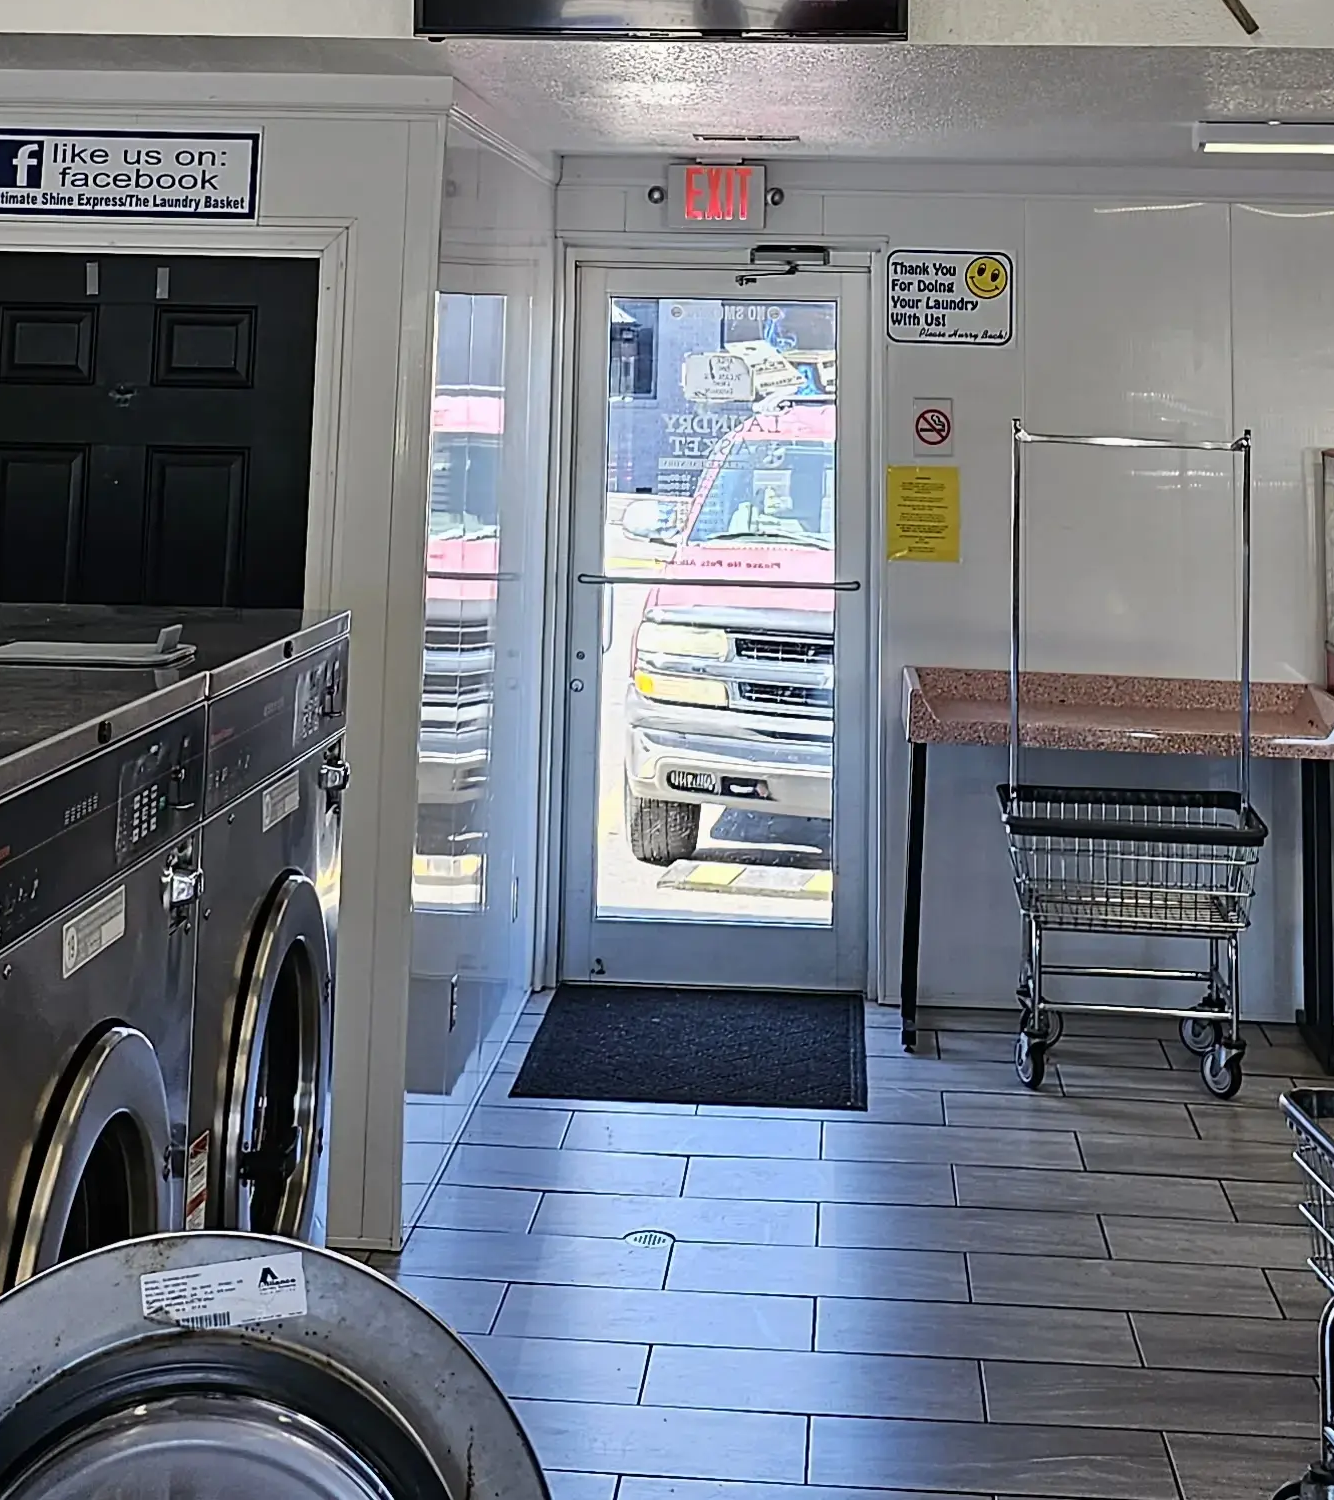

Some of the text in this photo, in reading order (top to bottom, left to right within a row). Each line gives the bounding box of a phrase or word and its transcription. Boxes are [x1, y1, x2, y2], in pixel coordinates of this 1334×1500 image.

[52, 143, 227, 167] like us on:
[58, 166, 219, 191] facebook
[685, 167, 753, 220] EXIT
[41, 192, 74, 207] Shine
[77, 193, 150, 210] Express/The
[152, 194, 201, 212] Laundry
[204, 195, 245, 210] Basket
[891, 261, 956, 276] Thank You
[891, 279, 955, 293] For Doing
[891, 295, 978, 311] Your Laundry
[891, 312, 946, 327] With Us!
[919, 328, 1007, 341] Please Hurry Back!
